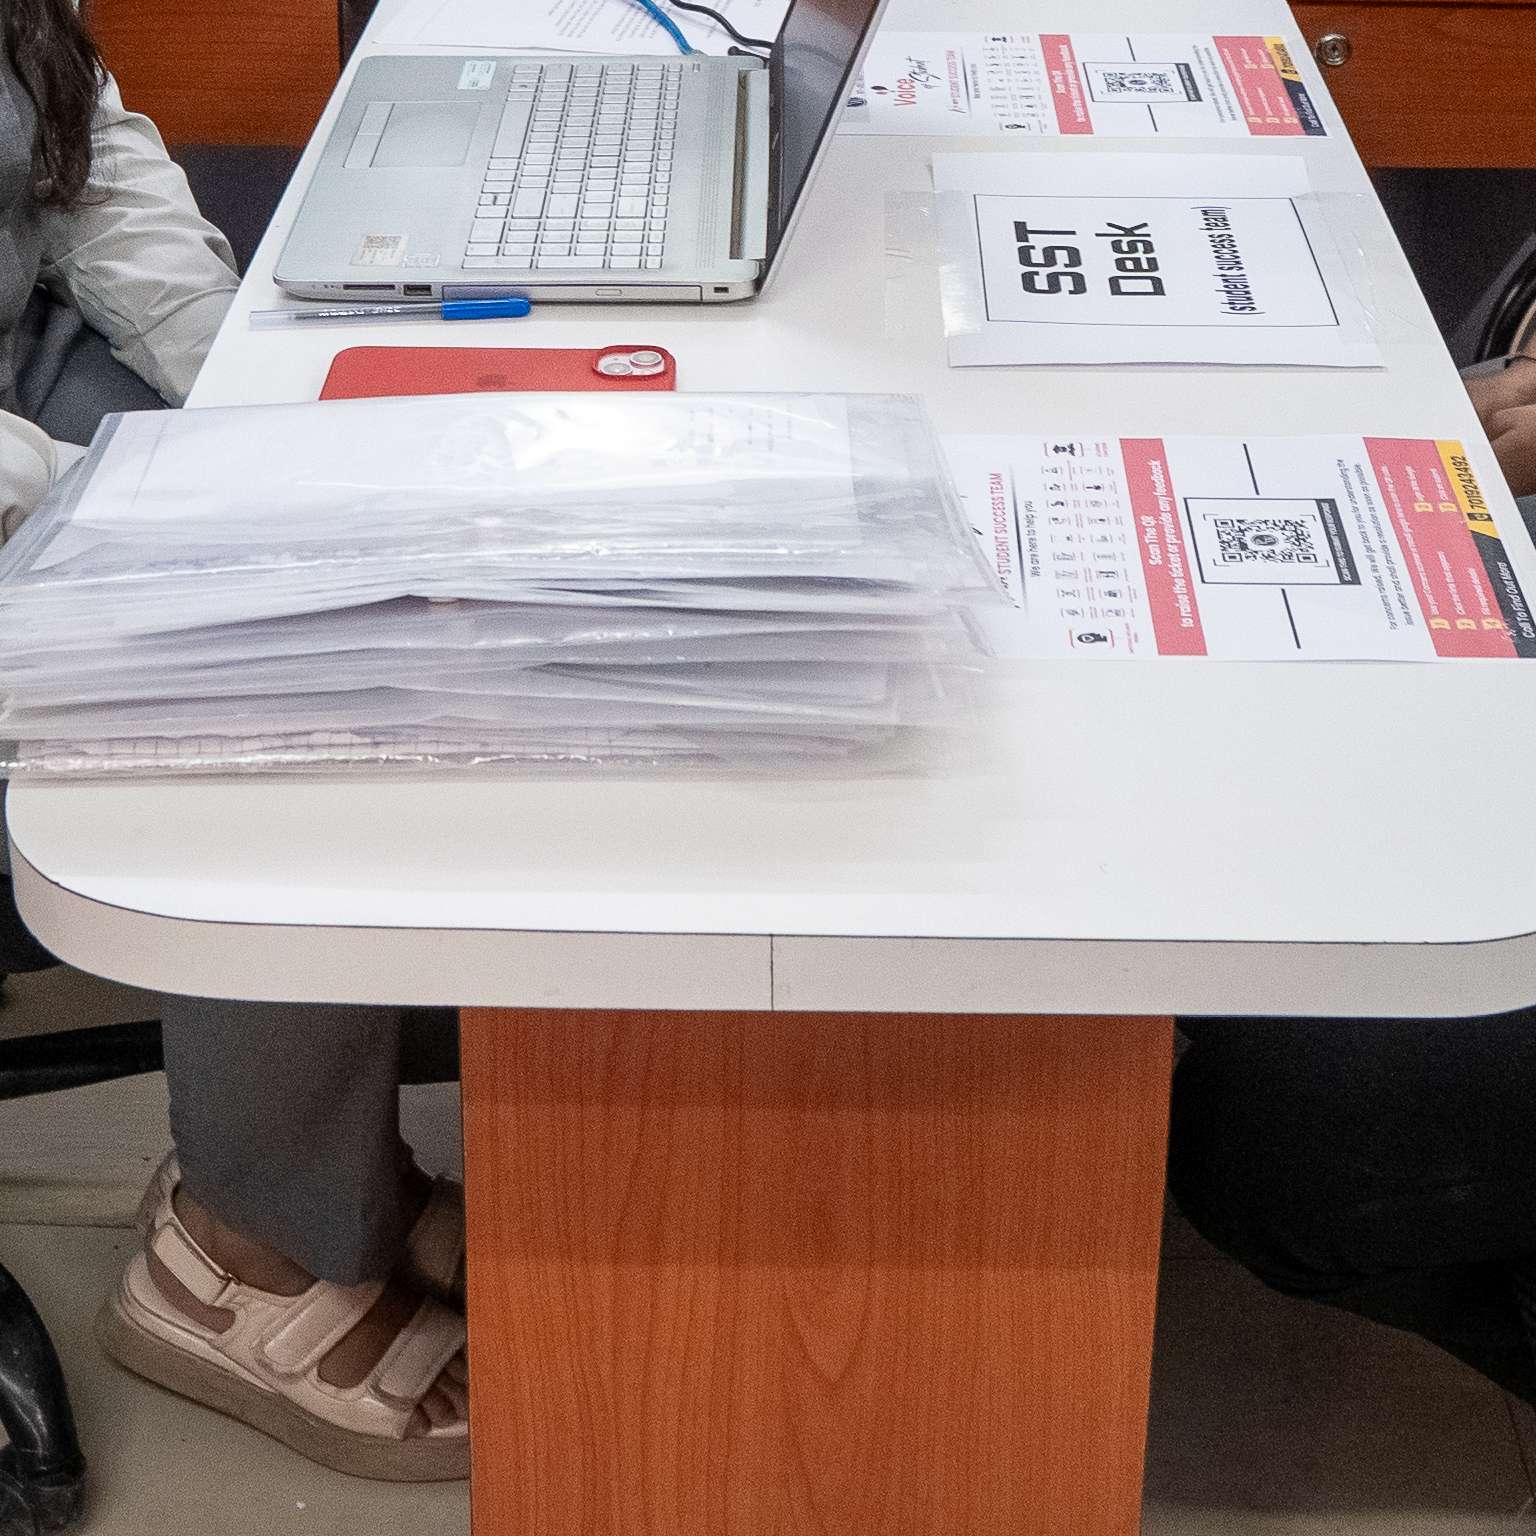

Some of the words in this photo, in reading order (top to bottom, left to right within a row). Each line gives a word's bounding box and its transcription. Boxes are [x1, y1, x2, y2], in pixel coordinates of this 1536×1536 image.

[894, 78, 917, 106] Voice
[1190, 205, 1233, 232] team)
[1013, 220, 1088, 296] SST
[1094, 221, 1166, 297] Desk
[1206, 234, 1238, 272] success
[1216, 271, 1266, 316] (student
[988, 472, 1004, 494] TEAM
[1147, 459, 1168, 495] feedback
[1449, 455, 1486, 509] 7019243492
[990, 496, 1008, 534] SUCCESS
[1023, 513, 1039, 528] help
[1140, 515, 1156, 526] QR
[1142, 527, 1159, 544] The
[1158, 512, 1181, 542] provide
[994, 536, 1011, 574] STUDENT
[1026, 537, 1038, 552] here
[1145, 545, 1163, 564] Scan
[1028, 565, 1041, 577] We
[1166, 552, 1184, 577] ticket
[1171, 578, 1188, 593] the
[1500, 580, 1520, 594] Out
[1174, 594, 1193, 617] raise
[1506, 594, 1526, 611] Find
[1179, 618, 1195, 627] to
[1513, 611, 1531, 621] To
